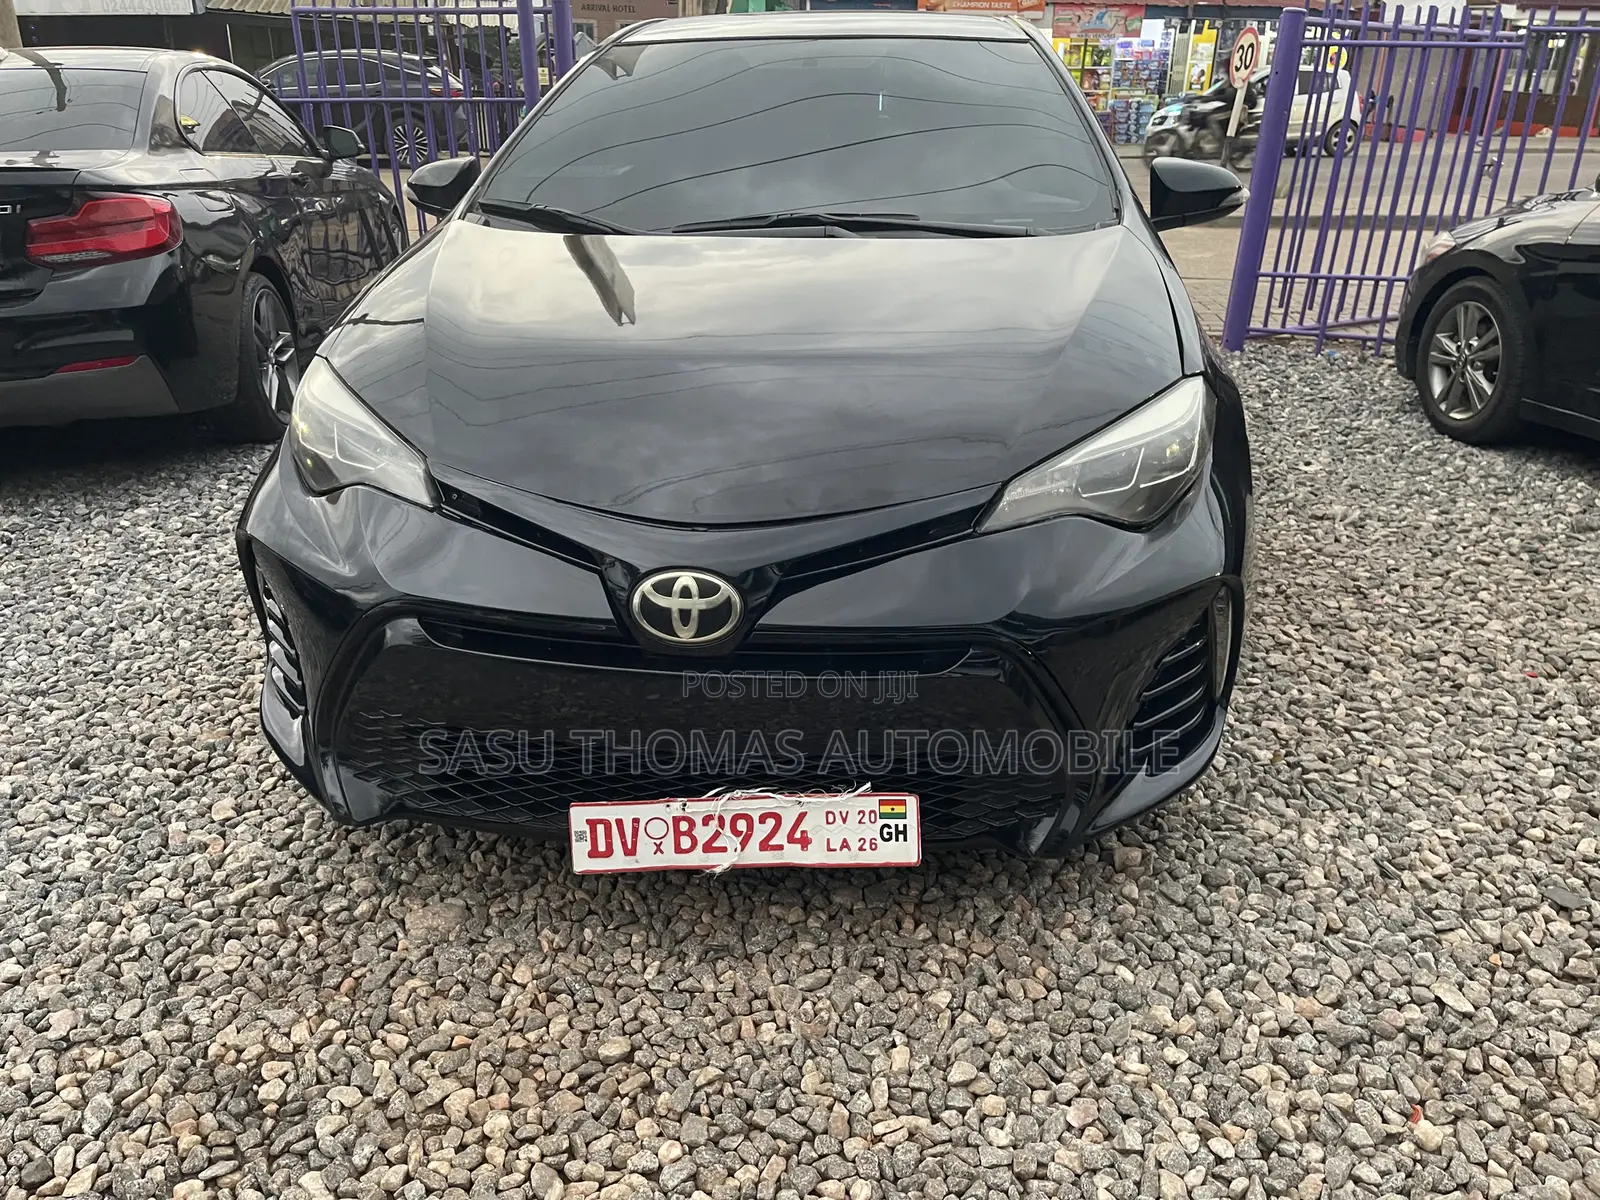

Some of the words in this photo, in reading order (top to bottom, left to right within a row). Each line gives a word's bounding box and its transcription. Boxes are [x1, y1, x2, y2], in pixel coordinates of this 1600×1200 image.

[581, 3, 611, 13] ARRIVAL
[612, 4, 636, 13] HOTEL
[990, 1, 1012, 9] TASTE
[1234, 42, 1255, 73] 30
[825, 809, 849, 825] DV
[857, 809, 878, 825] 20
[585, 817, 641, 859] DV
[671, 811, 813, 855] B2924
[879, 823, 908, 843] GH
[826, 837, 851, 852] LA
[857, 837, 878, 851] 26
